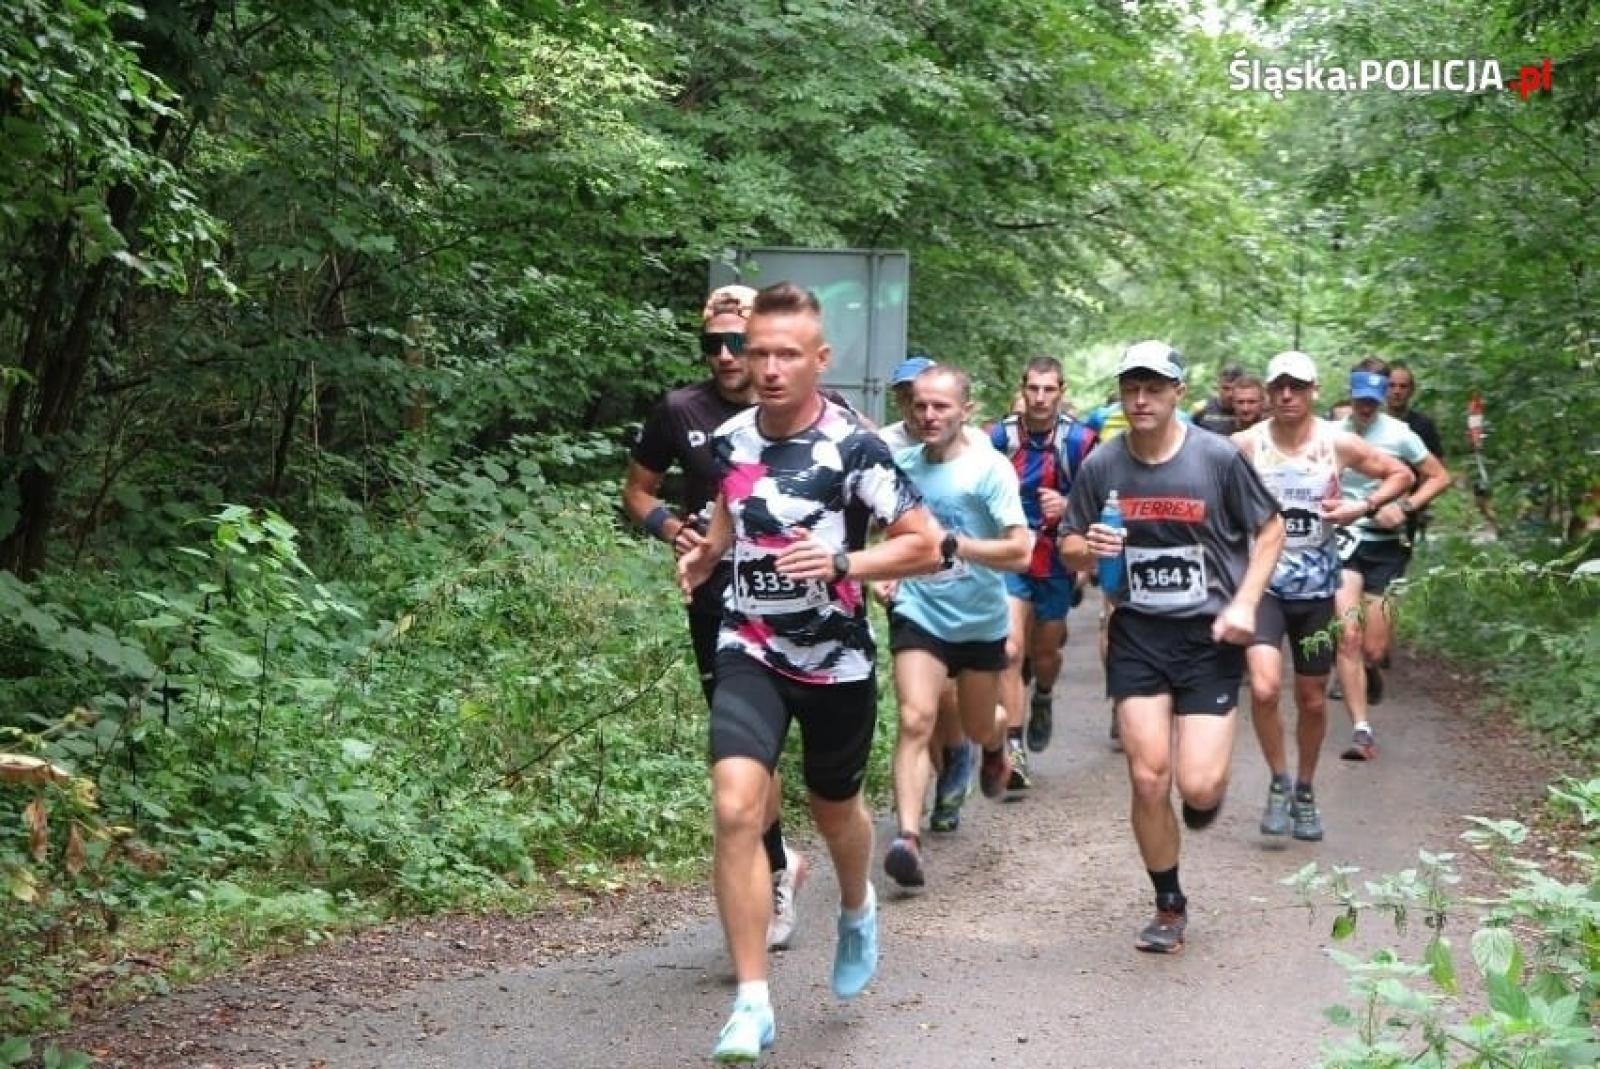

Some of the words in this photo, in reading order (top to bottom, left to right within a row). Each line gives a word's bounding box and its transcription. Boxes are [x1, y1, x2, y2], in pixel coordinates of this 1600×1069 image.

[1128, 500, 1198, 517] TERREX
[752, 570, 796, 591] 333
[1145, 567, 1182, 587] 364
